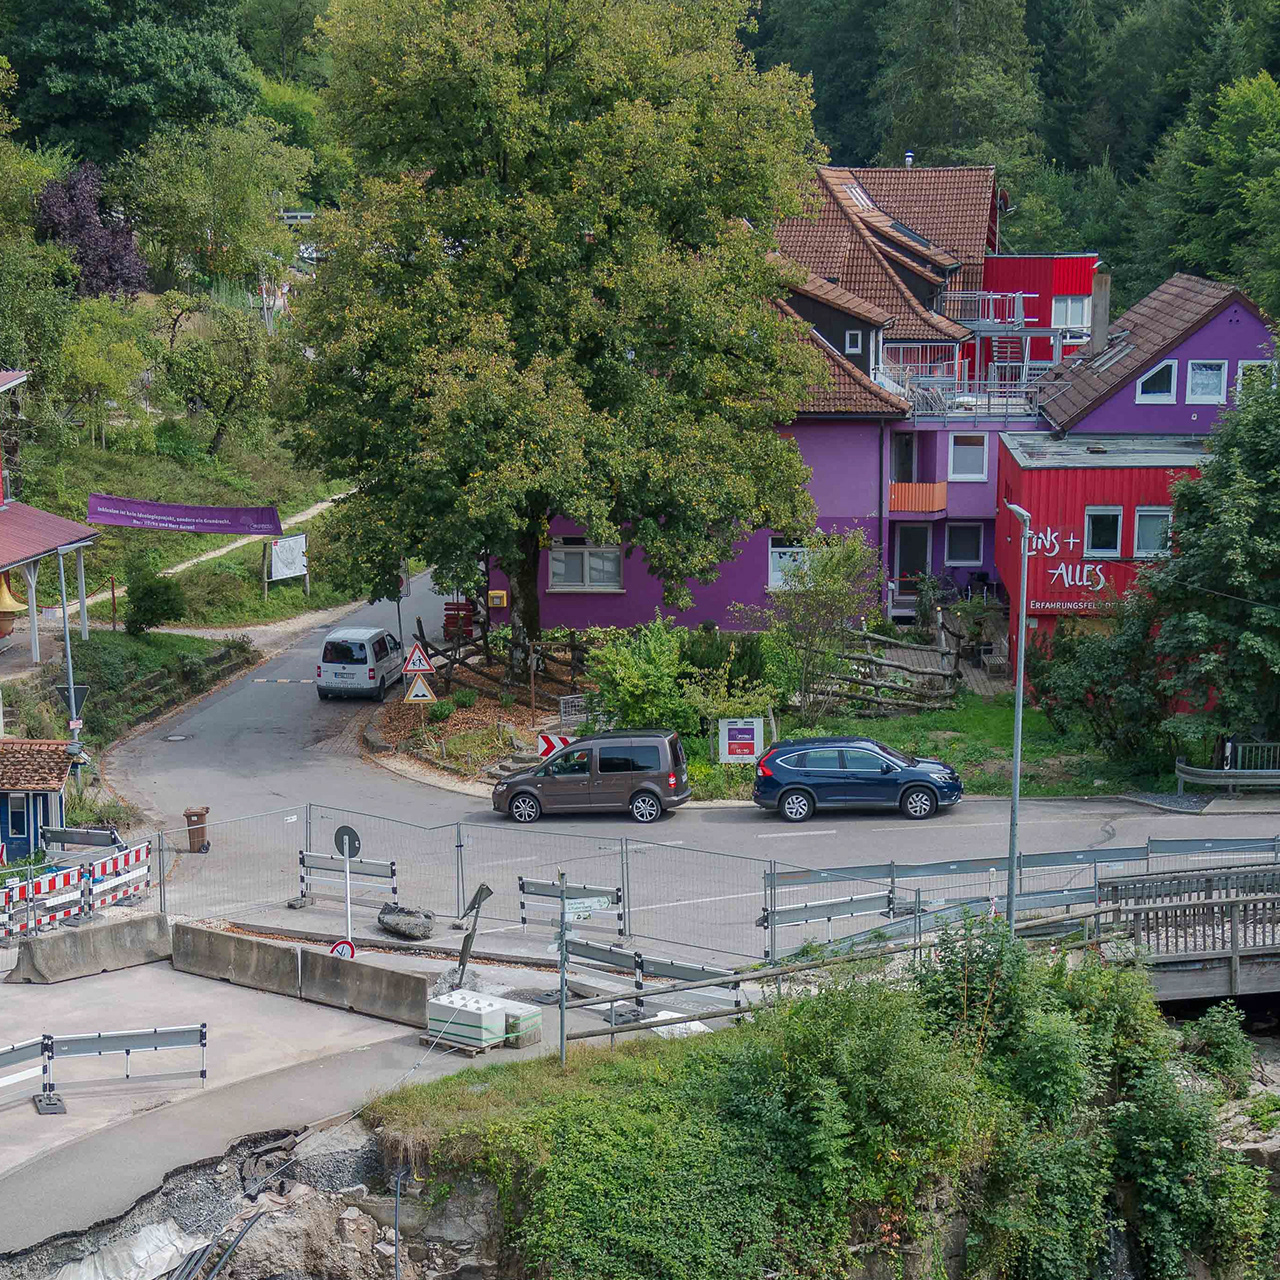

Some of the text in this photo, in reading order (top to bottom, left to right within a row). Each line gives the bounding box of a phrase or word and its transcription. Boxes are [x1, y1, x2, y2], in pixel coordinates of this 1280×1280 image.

[97, 506, 119, 514] Inklusion
[1064, 532, 1081, 550] +
[1047, 562, 1105, 591] ALLES
